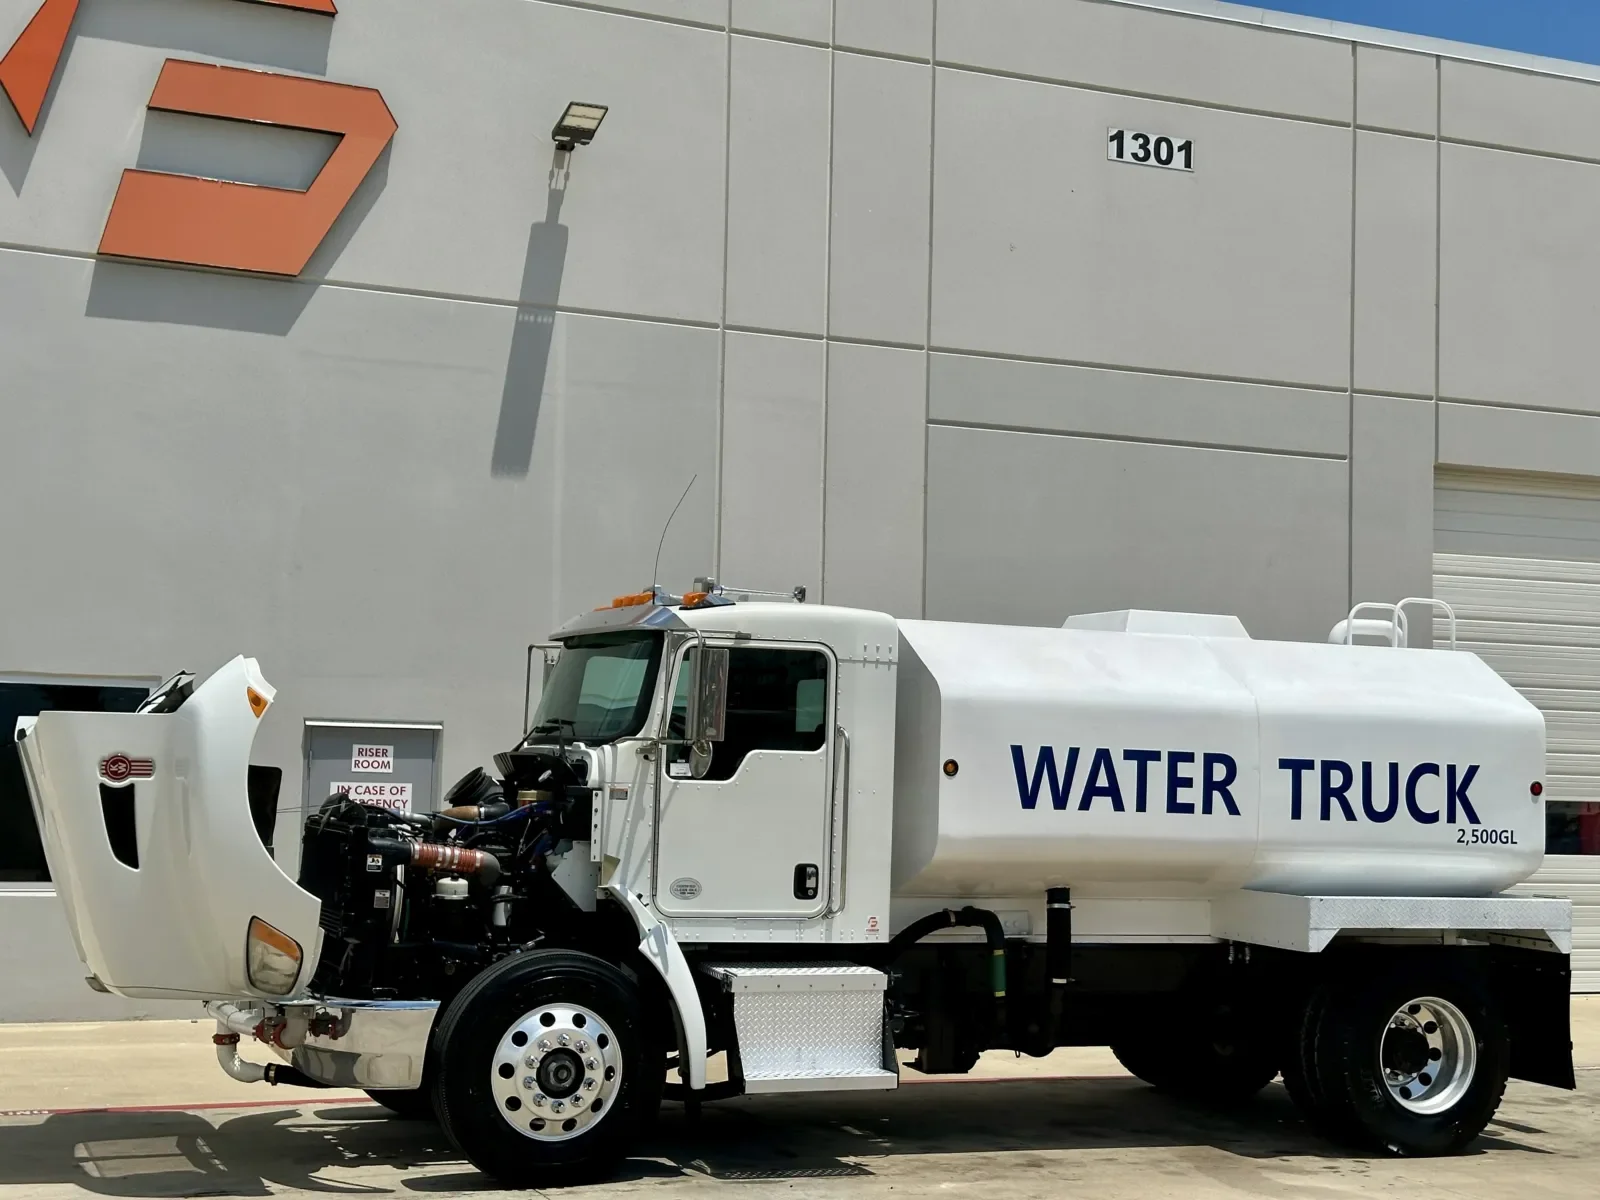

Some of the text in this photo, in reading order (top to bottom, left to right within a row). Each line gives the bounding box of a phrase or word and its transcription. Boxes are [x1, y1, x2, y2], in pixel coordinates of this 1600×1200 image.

[1109, 129, 1192, 168] 1301
[357, 747, 388, 757] RISER
[354, 759, 391, 769] ROOM
[354, 785, 385, 796] CASE
[389, 786, 406, 796] OF
[1010, 744, 1481, 825] WATER TRUCK
[1457, 828, 1518, 846] 2,500GL
